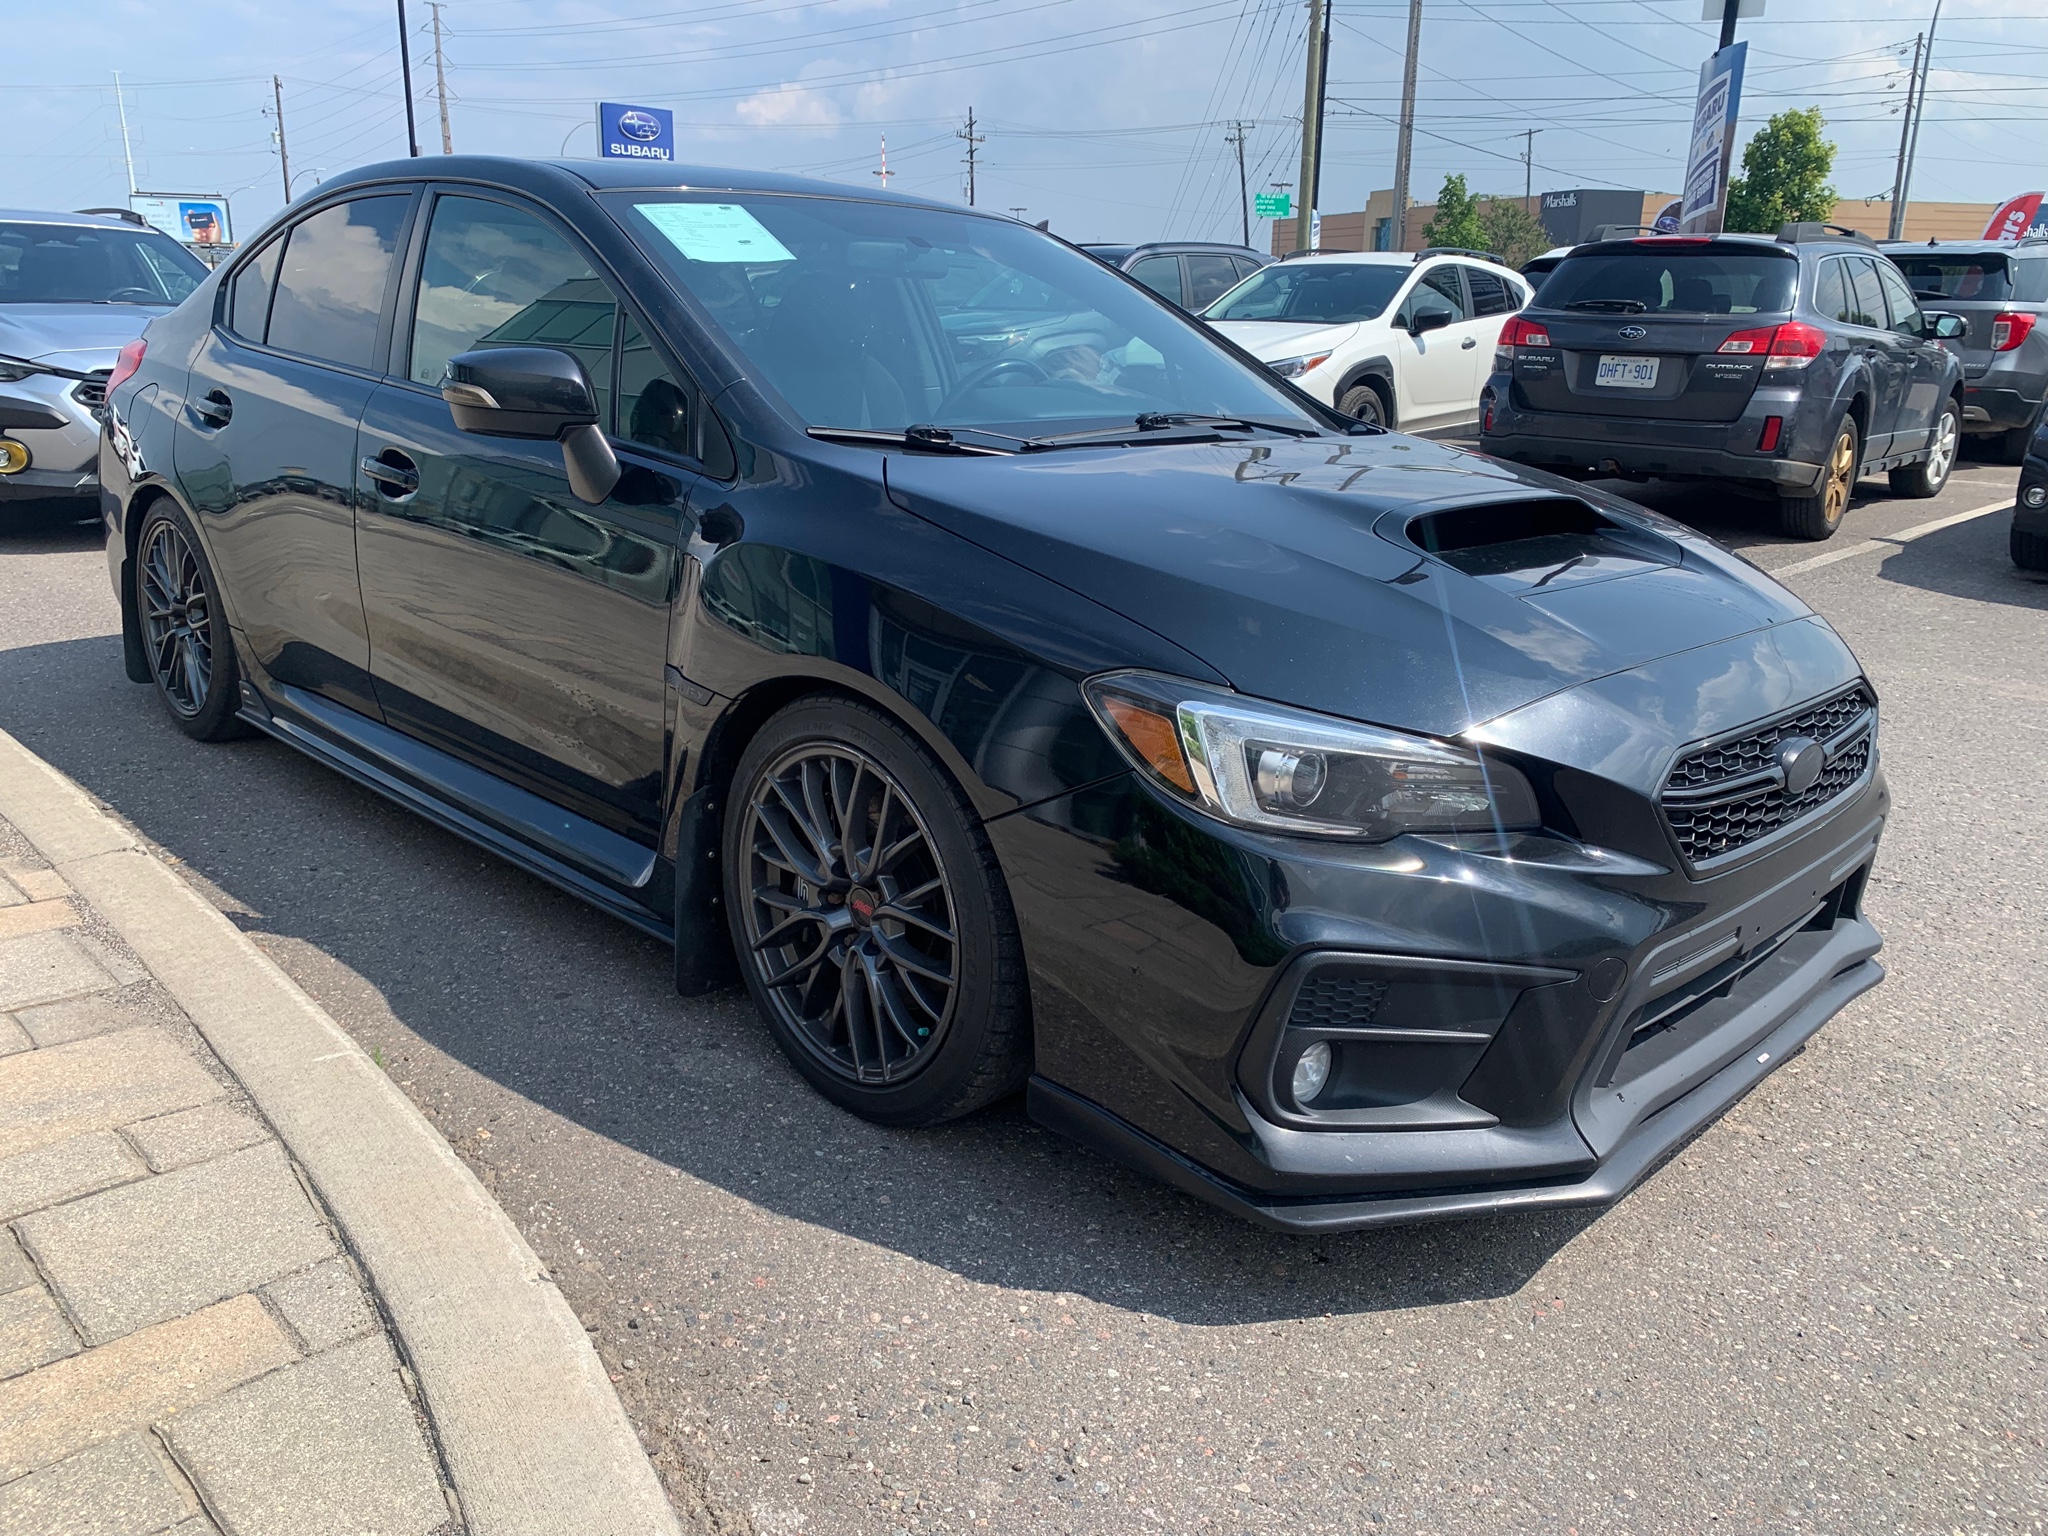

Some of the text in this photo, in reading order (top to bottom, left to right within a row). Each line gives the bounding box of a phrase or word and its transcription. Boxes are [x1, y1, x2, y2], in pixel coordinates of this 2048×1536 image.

[1695, 91, 1726, 136] SUBARU
[610, 143, 669, 159] SUBARU
[1543, 193, 1577, 208] Marshalls
[1997, 210, 2026, 240] ars
[2022, 223, 2048, 238] shalls
[1599, 363, 1653, 380] DHFT 901
[1706, 363, 1753, 371] OUTBACK
